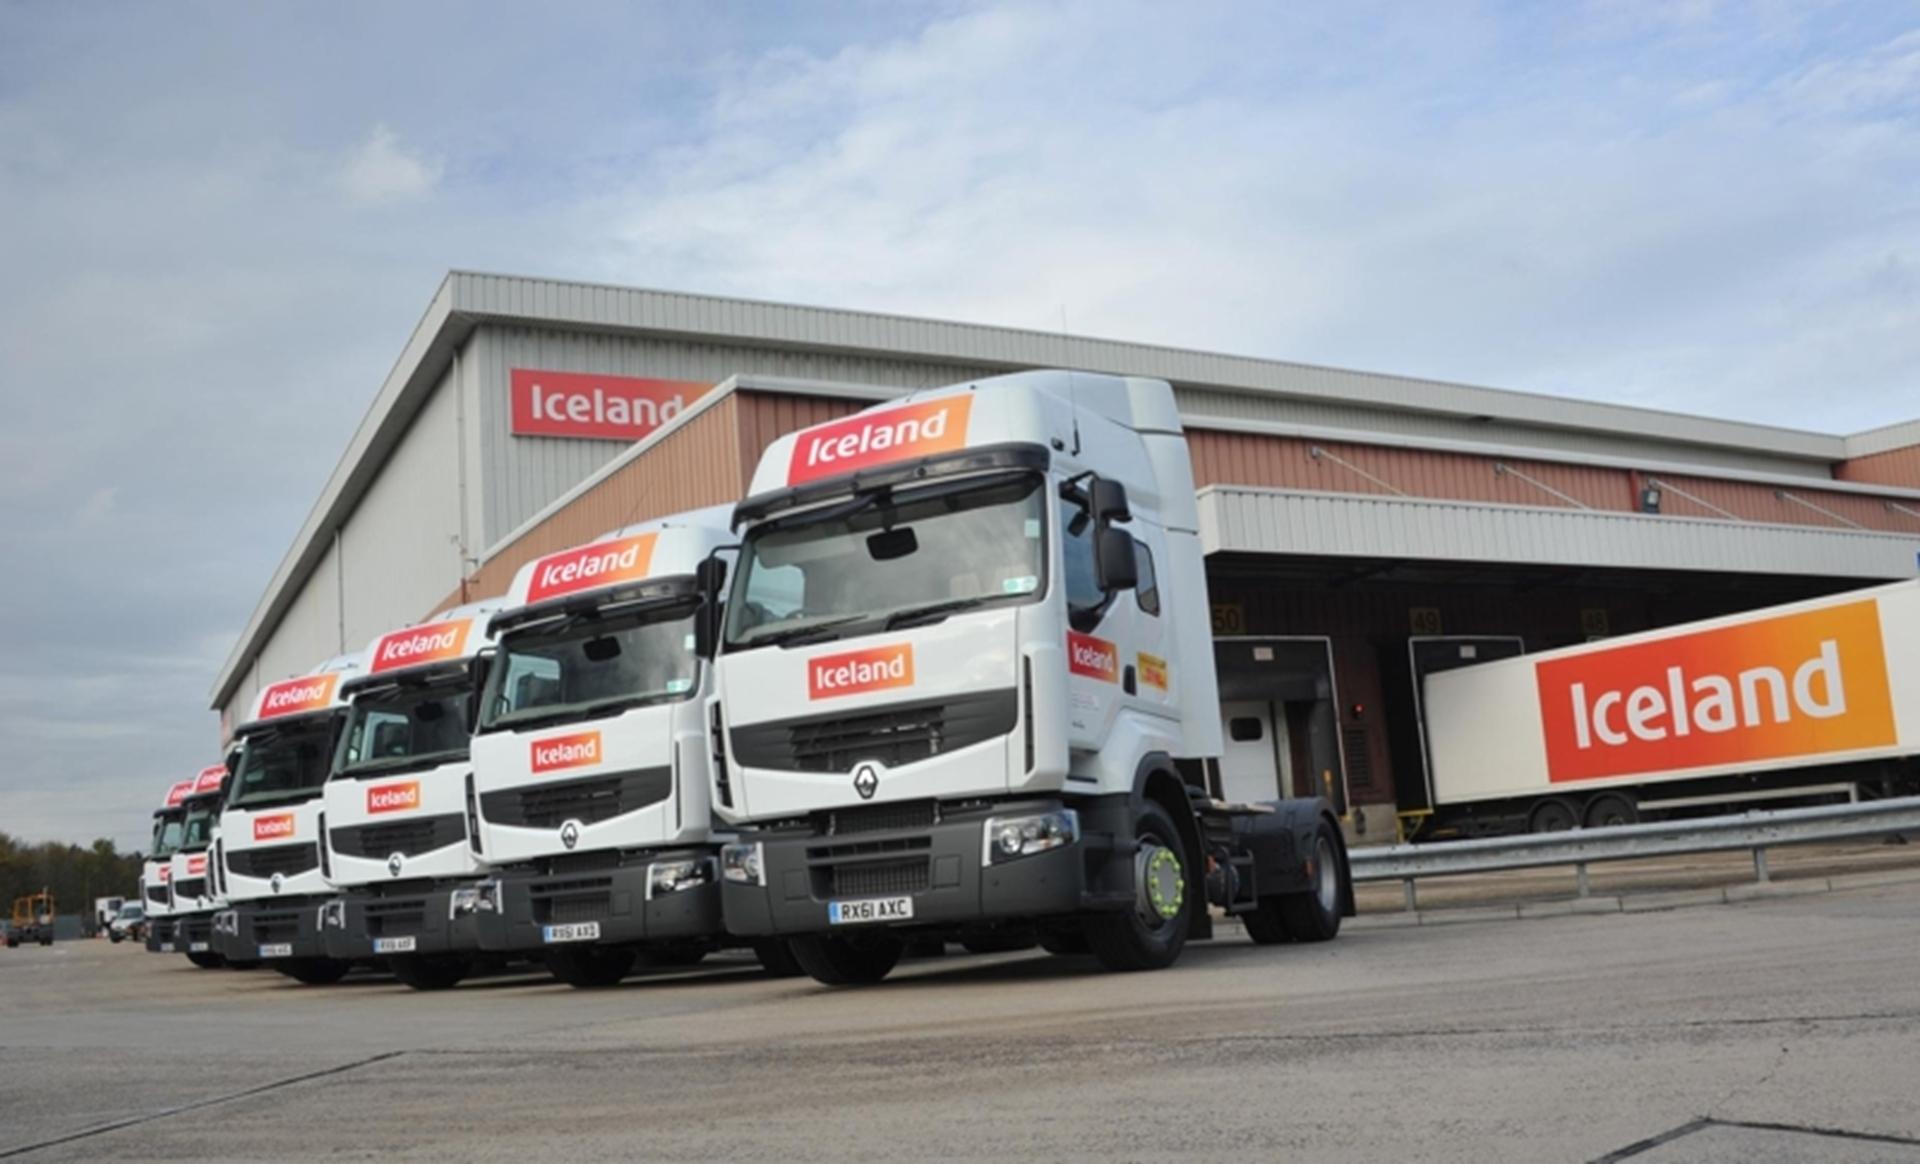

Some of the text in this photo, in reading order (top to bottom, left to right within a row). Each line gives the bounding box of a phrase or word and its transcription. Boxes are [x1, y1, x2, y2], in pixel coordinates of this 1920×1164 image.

[532, 384, 684, 426] Iceland
[807, 408, 948, 467] Iceland
[541, 543, 639, 588] Iceland
[1415, 612, 1437, 632] 49
[382, 627, 459, 661] Iceland
[1073, 641, 1114, 673] Iceland
[816, 653, 905, 690] Iceland
[266, 681, 328, 708] Iceland
[1570, 639, 1847, 749] Iceland
[536, 739, 596, 766] Iceland
[371, 786, 416, 808] Iceland
[842, 899, 907, 920] RX61 AXC
